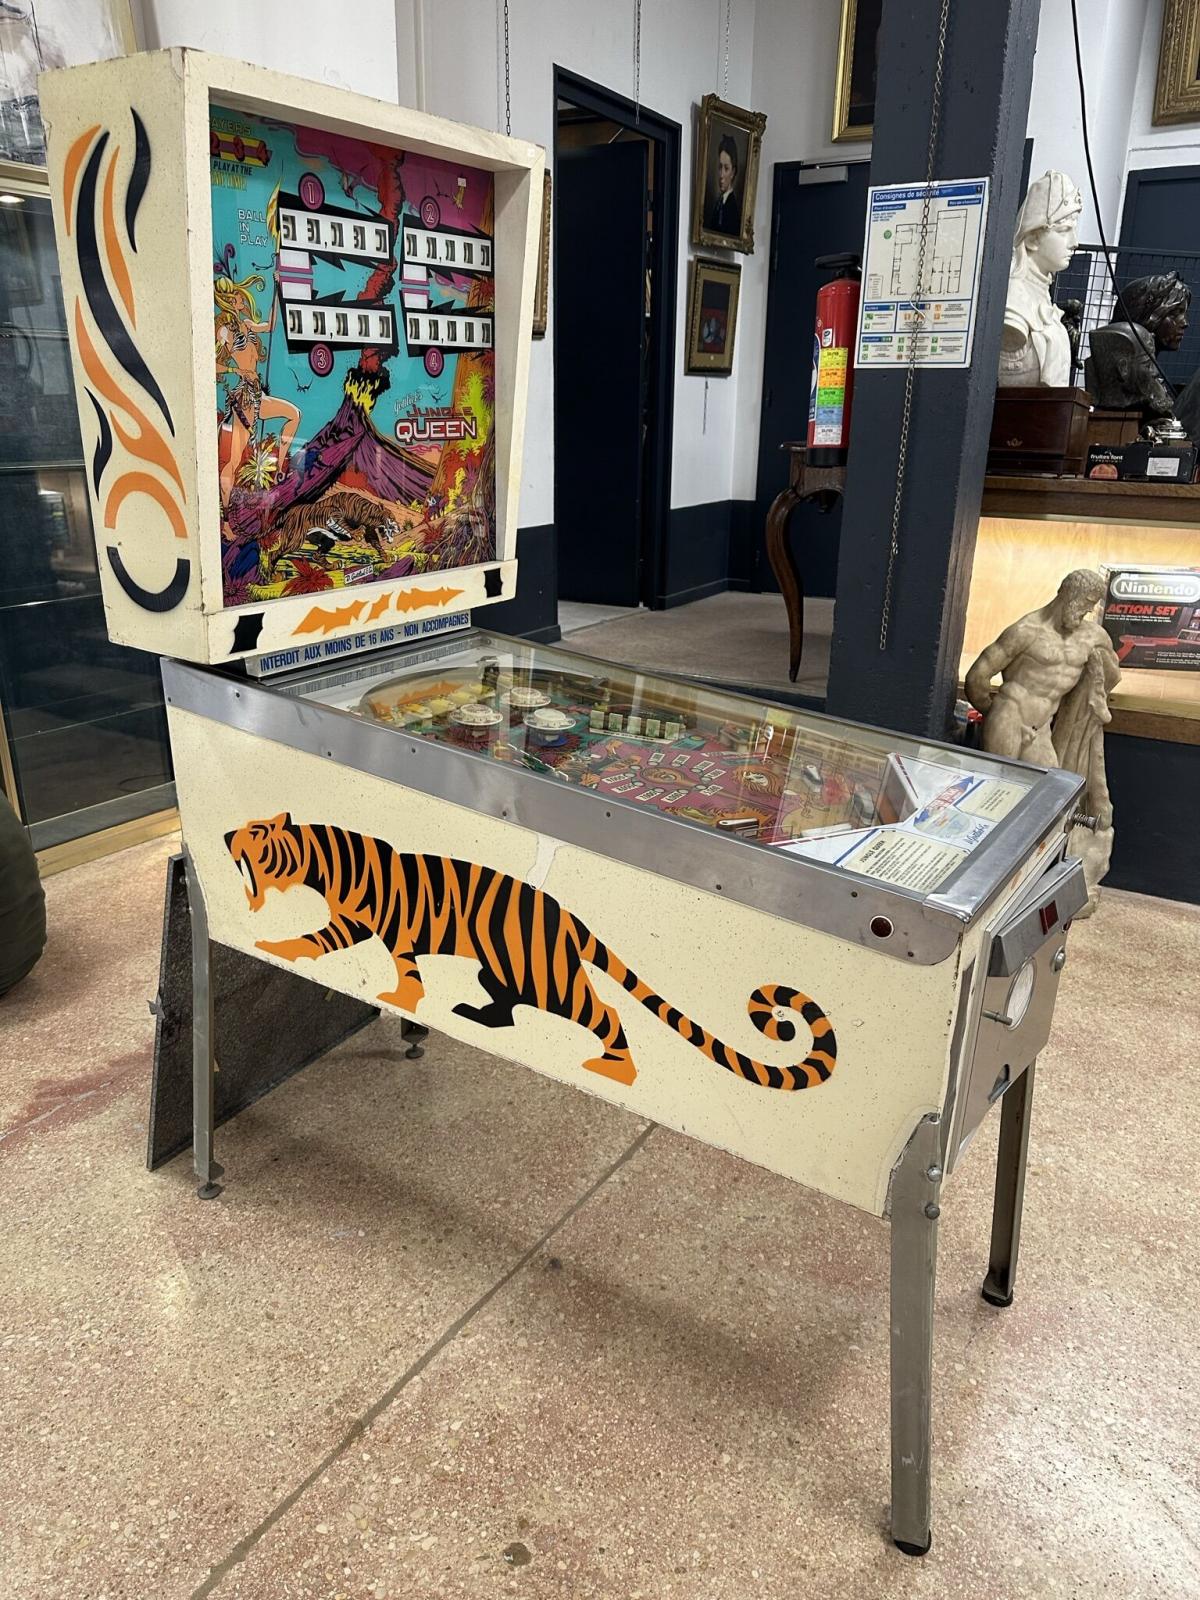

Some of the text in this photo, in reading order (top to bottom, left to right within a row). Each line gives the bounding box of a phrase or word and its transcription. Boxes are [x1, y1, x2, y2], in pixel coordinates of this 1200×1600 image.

[213, 160, 231, 172] PLAY
[308, 183, 315, 203] 1
[875, 192, 906, 201] Consignes
[238, 209, 267, 223] BALL
[426, 203, 435, 222] 2
[239, 222, 250, 233] IN
[240, 234, 268, 247] PLAY
[316, 350, 327, 369] 3
[429, 353, 438, 369] 4
[395, 418, 477, 444] QUEEN
[1120, 581, 1195, 596] Nintendo
[1106, 603, 1179, 616] ACTION SET
[260, 651, 299, 672] INTERDIT
[304, 644, 321, 660] AUX
[325, 638, 352, 655] MOINS
[355, 635, 366, 649] DE
[369, 632, 377, 645] 16
[380, 628, 394, 643] ANS
[404, 622, 419, 637] NON
[422, 614, 469, 633] ACCOMPAGNES
